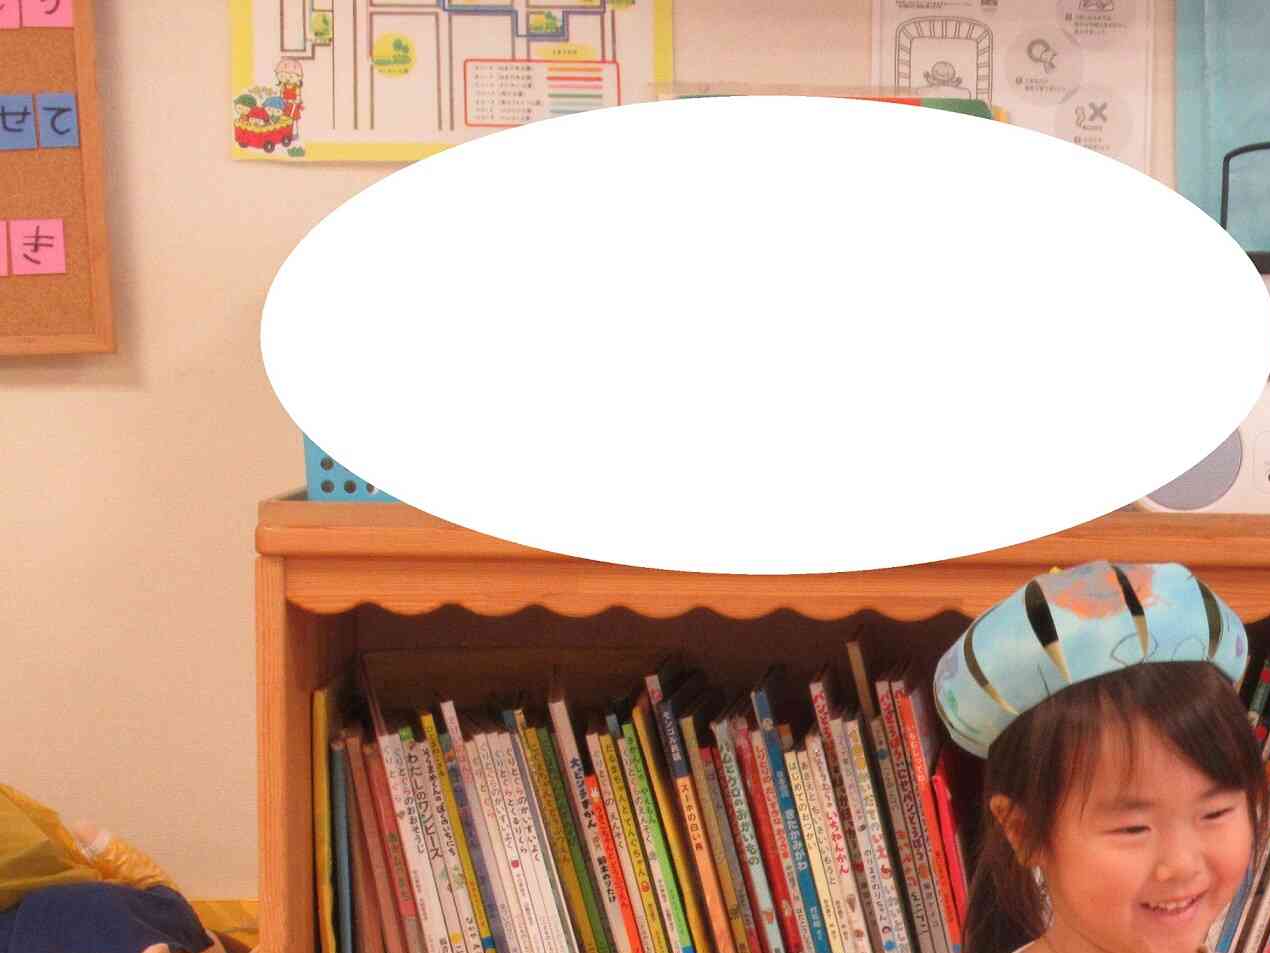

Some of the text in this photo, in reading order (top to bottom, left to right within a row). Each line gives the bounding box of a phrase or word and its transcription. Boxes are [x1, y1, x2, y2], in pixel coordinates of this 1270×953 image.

[23, 225, 54, 264] き
[407, 754, 443, 860] わたしのワンピース
[570, 756, 598, 829] 大ピンチずかん
[680, 784, 704, 851] スーホの白い馬
[721, 744, 761, 866] バムとケロのおかいもの
